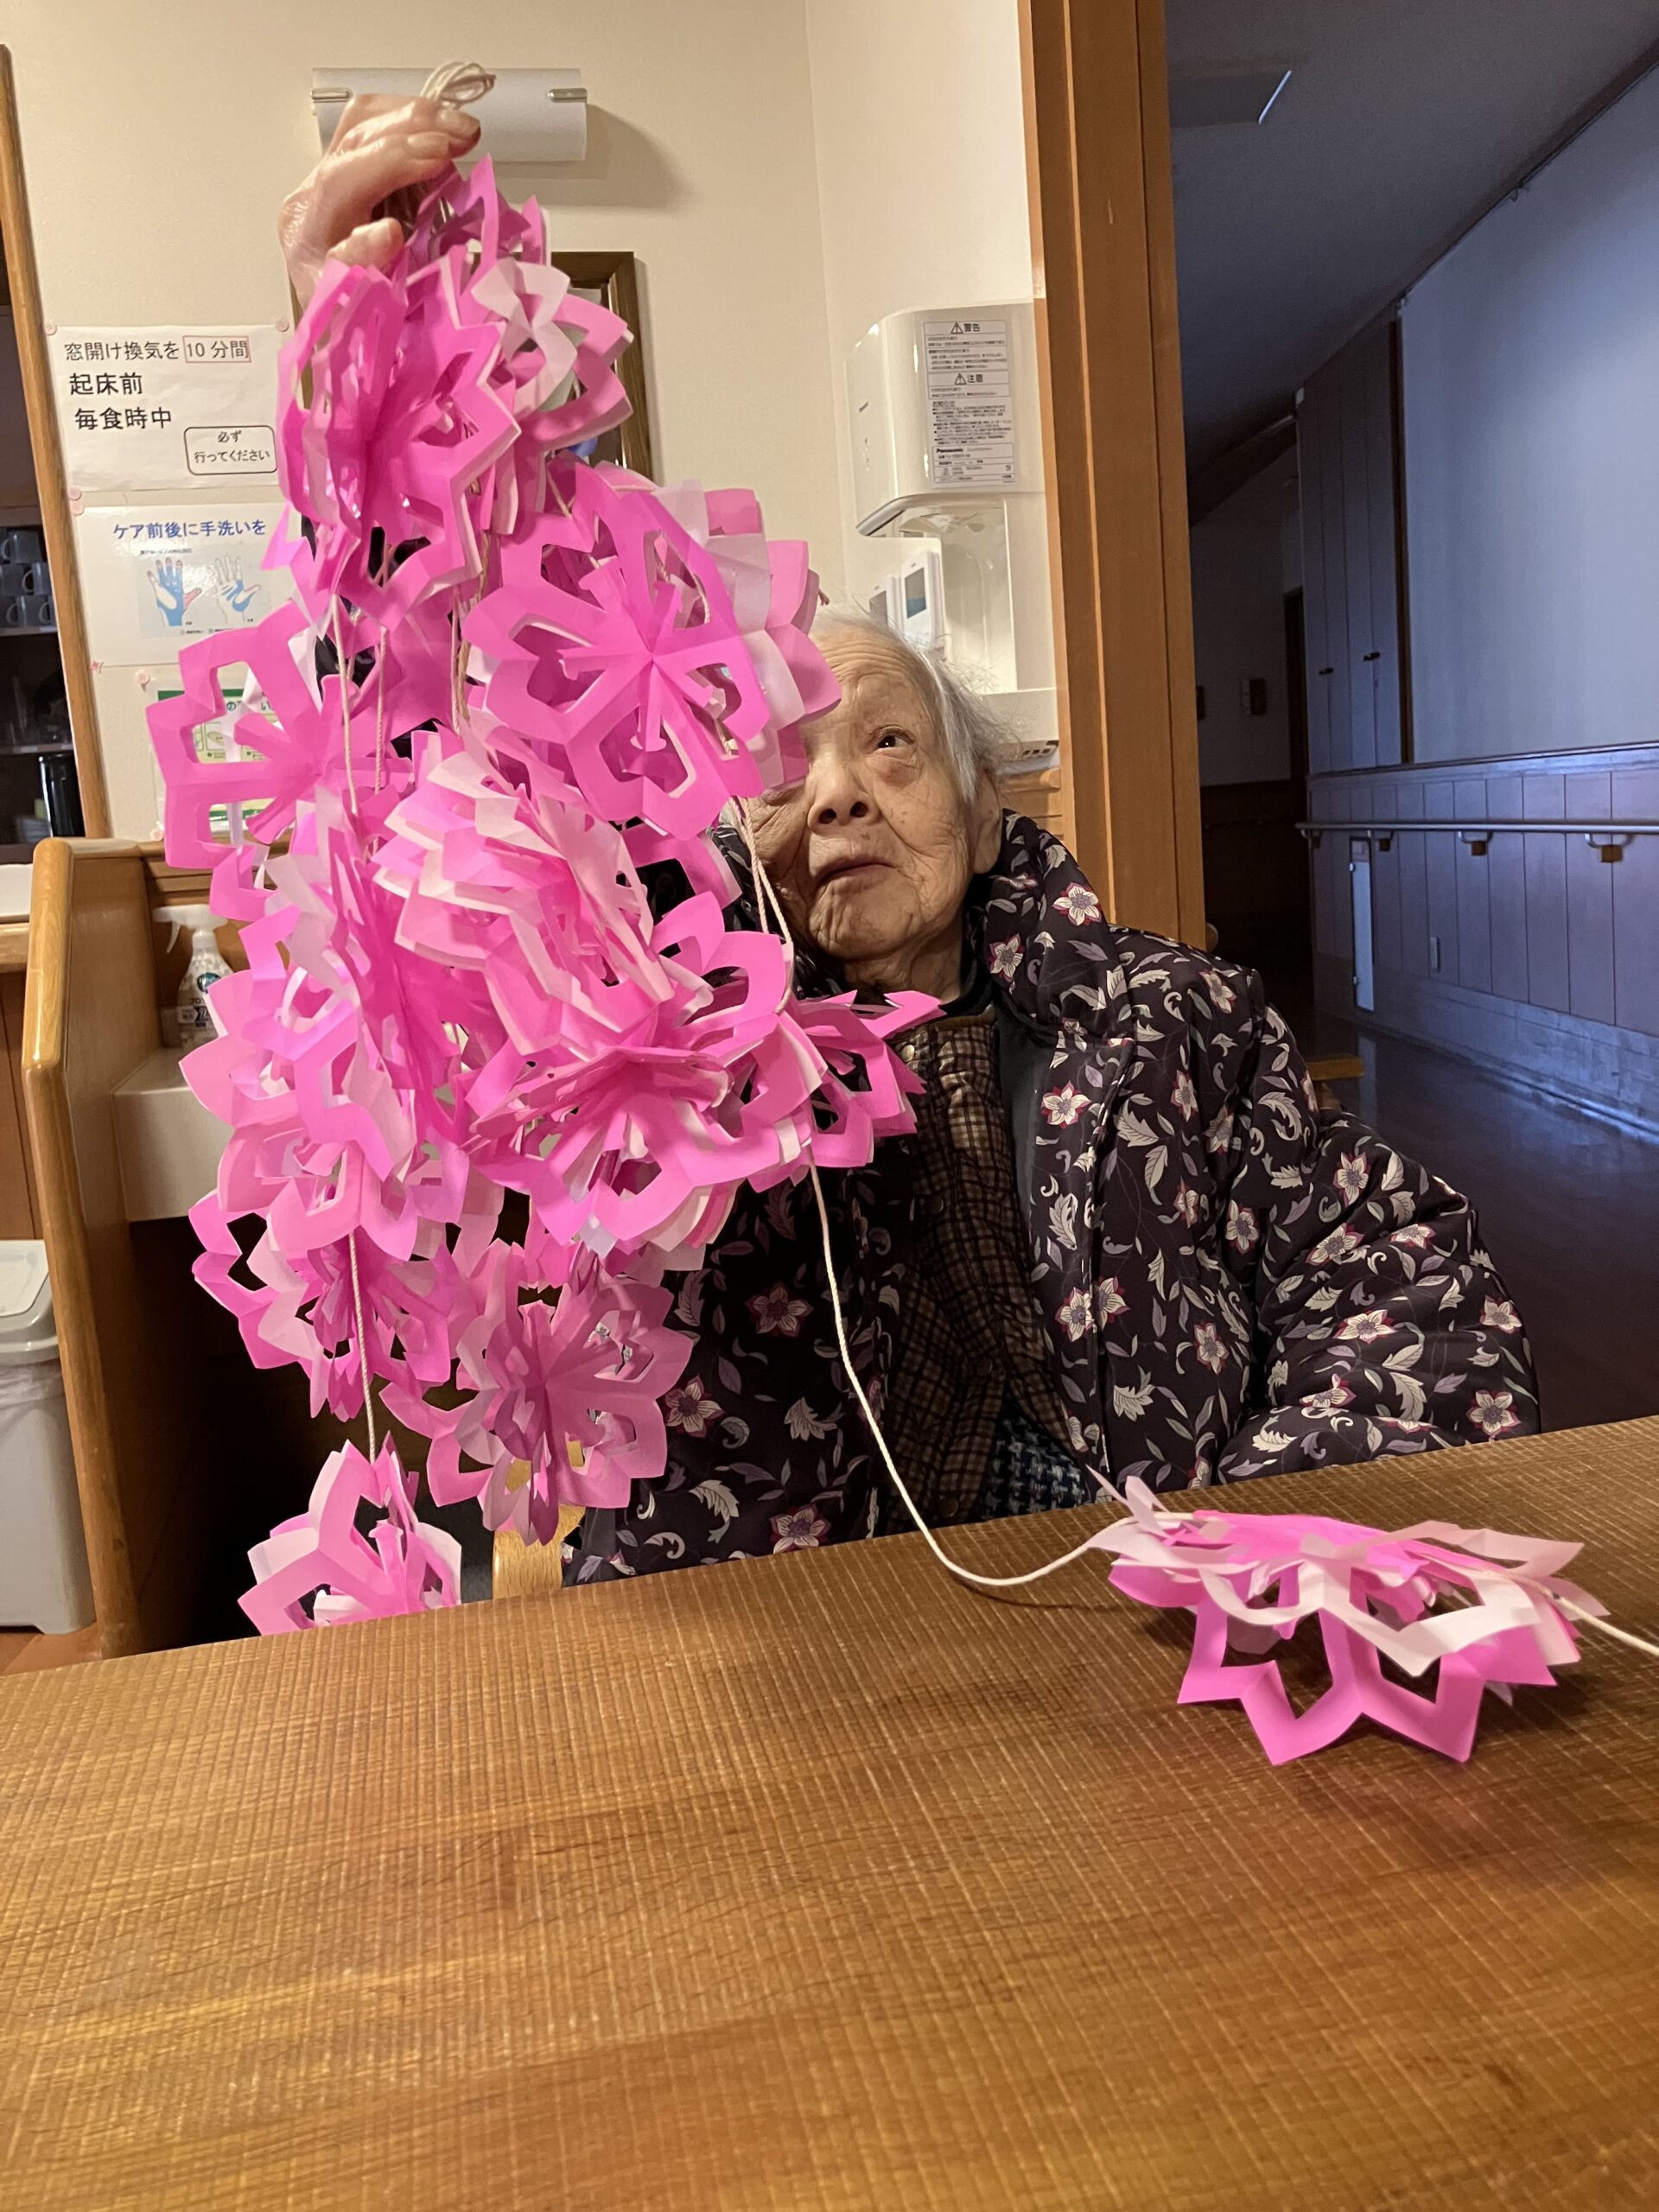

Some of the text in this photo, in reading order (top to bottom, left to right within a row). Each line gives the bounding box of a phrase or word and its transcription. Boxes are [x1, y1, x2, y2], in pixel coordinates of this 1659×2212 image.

[64, 340, 179, 361] 窓開け換気を
[69, 372, 143, 396] 起床前
[74, 406, 172, 430] 毎食時中
[218, 430, 242, 443] 必ず
[194, 449, 271, 464] 行ってください
[113, 518, 266, 539] ケア前後に手洗いを
